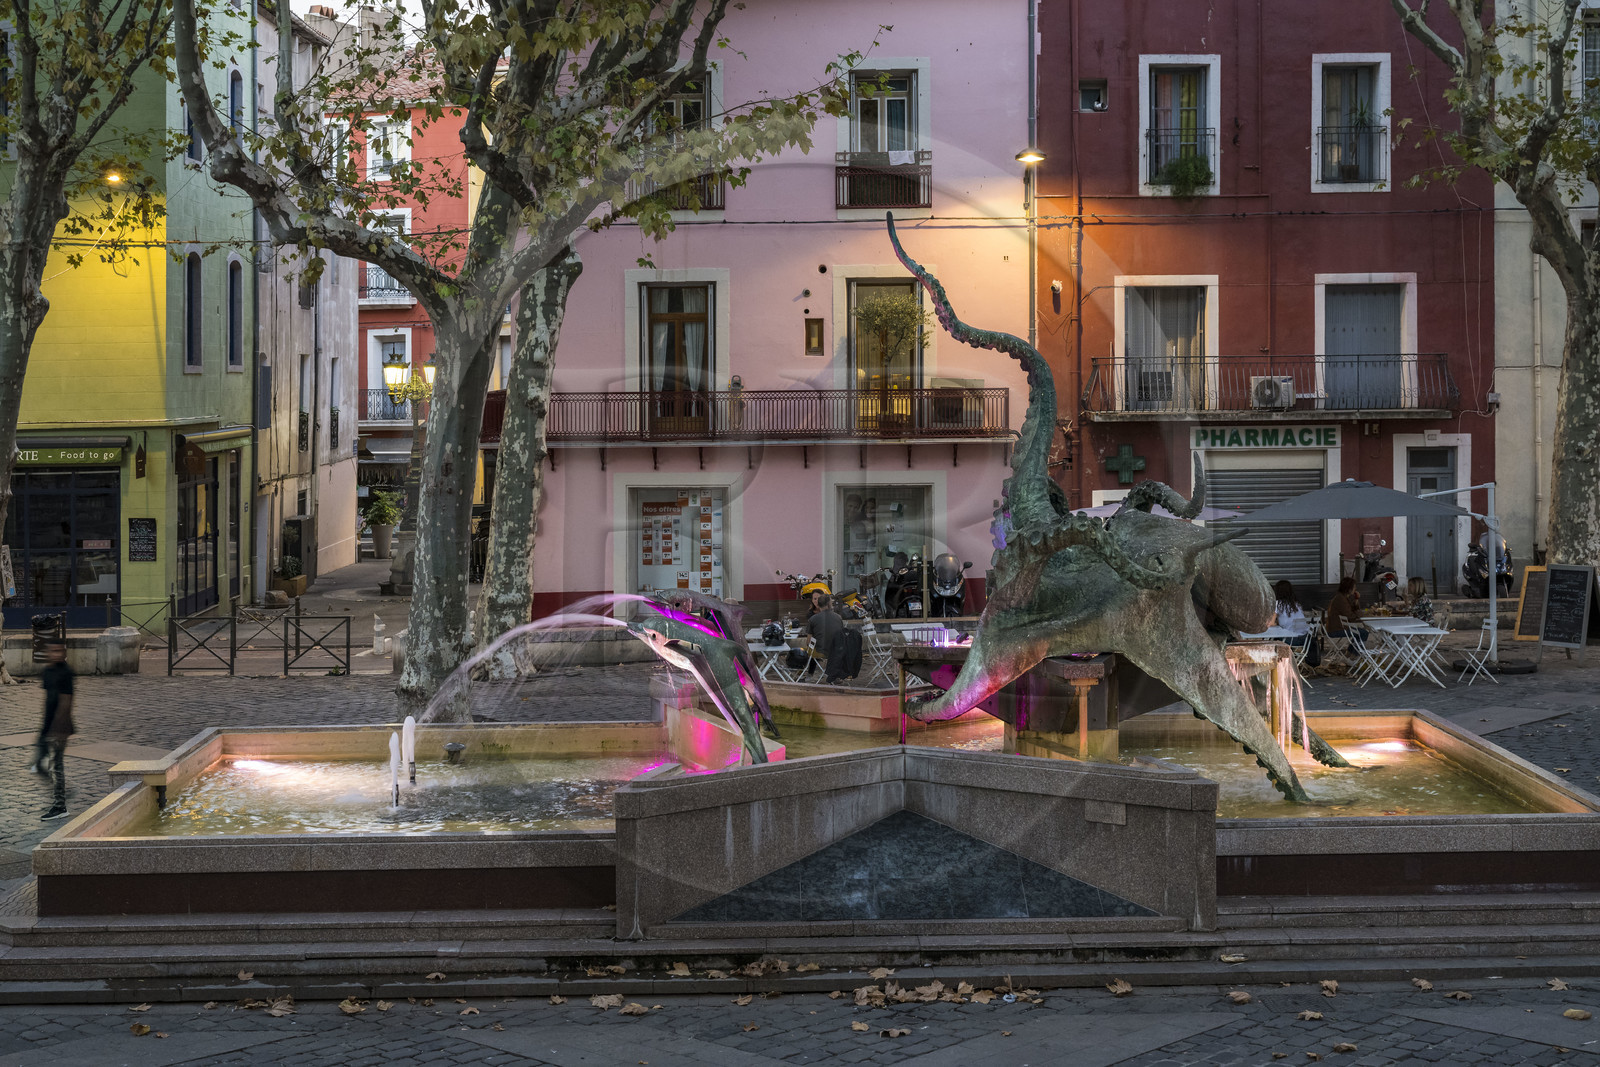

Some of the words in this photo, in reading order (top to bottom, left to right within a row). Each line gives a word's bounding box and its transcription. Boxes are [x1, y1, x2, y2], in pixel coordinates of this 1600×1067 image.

[1195, 428, 1337, 447] PHARMACIE
[60, 451, 85, 459] Food
[89, 451, 99, 459] to
[103, 452, 115, 460] go
[659, 505, 681, 513] offres
